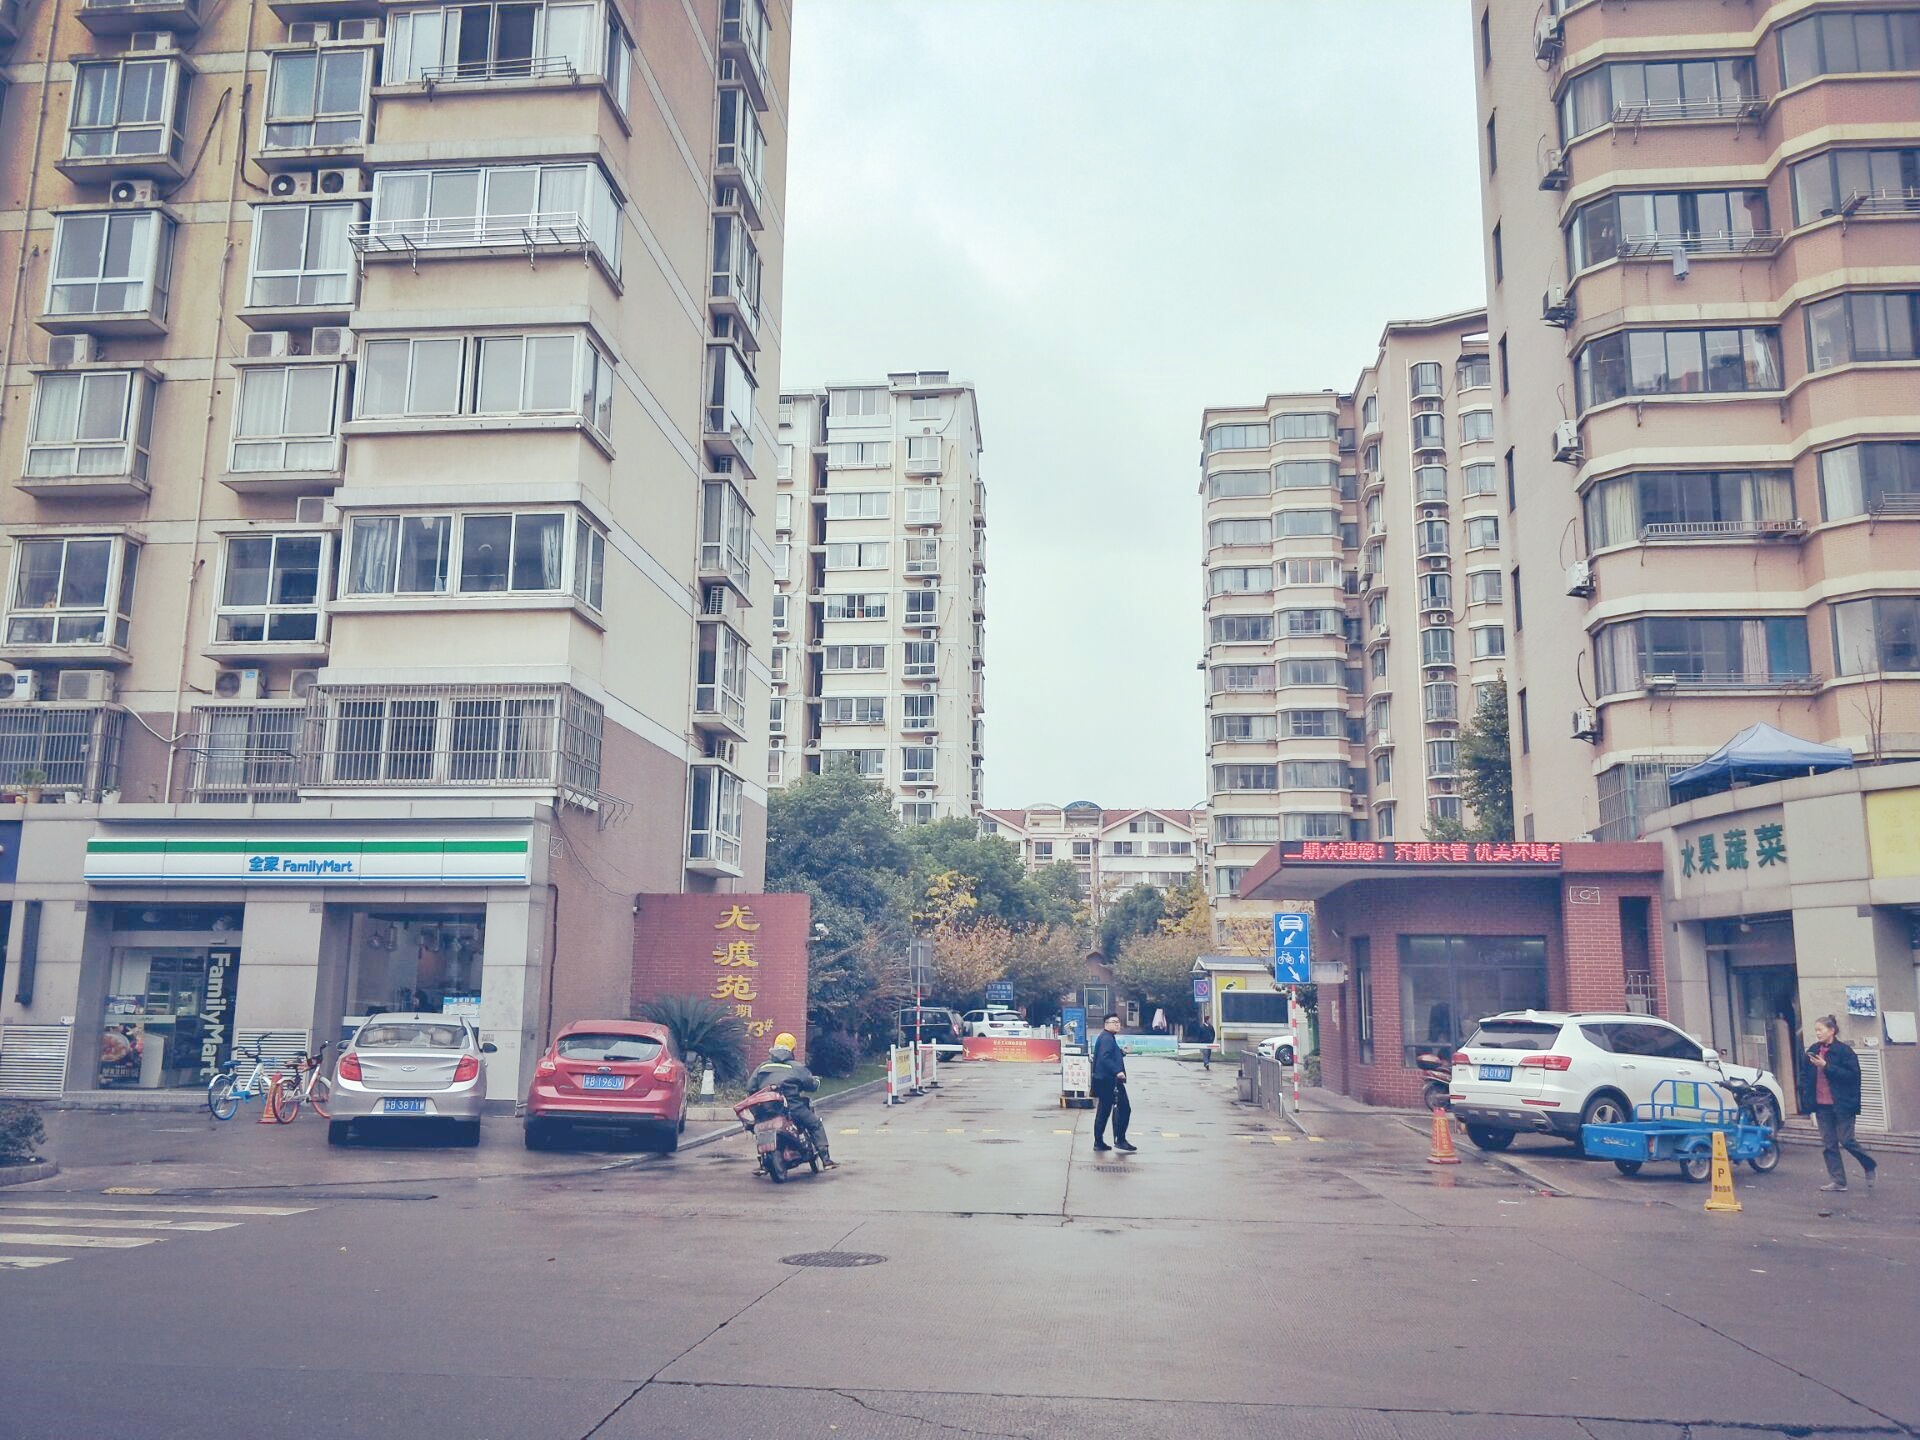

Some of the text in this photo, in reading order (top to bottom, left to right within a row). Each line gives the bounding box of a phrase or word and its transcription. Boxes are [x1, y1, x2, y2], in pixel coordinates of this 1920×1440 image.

[248, 856, 353, 876] 全家 FamilyMart
[1394, 843, 1469, 861] 齐抓共管
[1681, 823, 1788, 878] 水果蔬菜
[710, 904, 760, 1001] 尤渡苑
[200, 953, 231, 1077] FamilyMart
[1717, 1167, 1725, 1178] P
